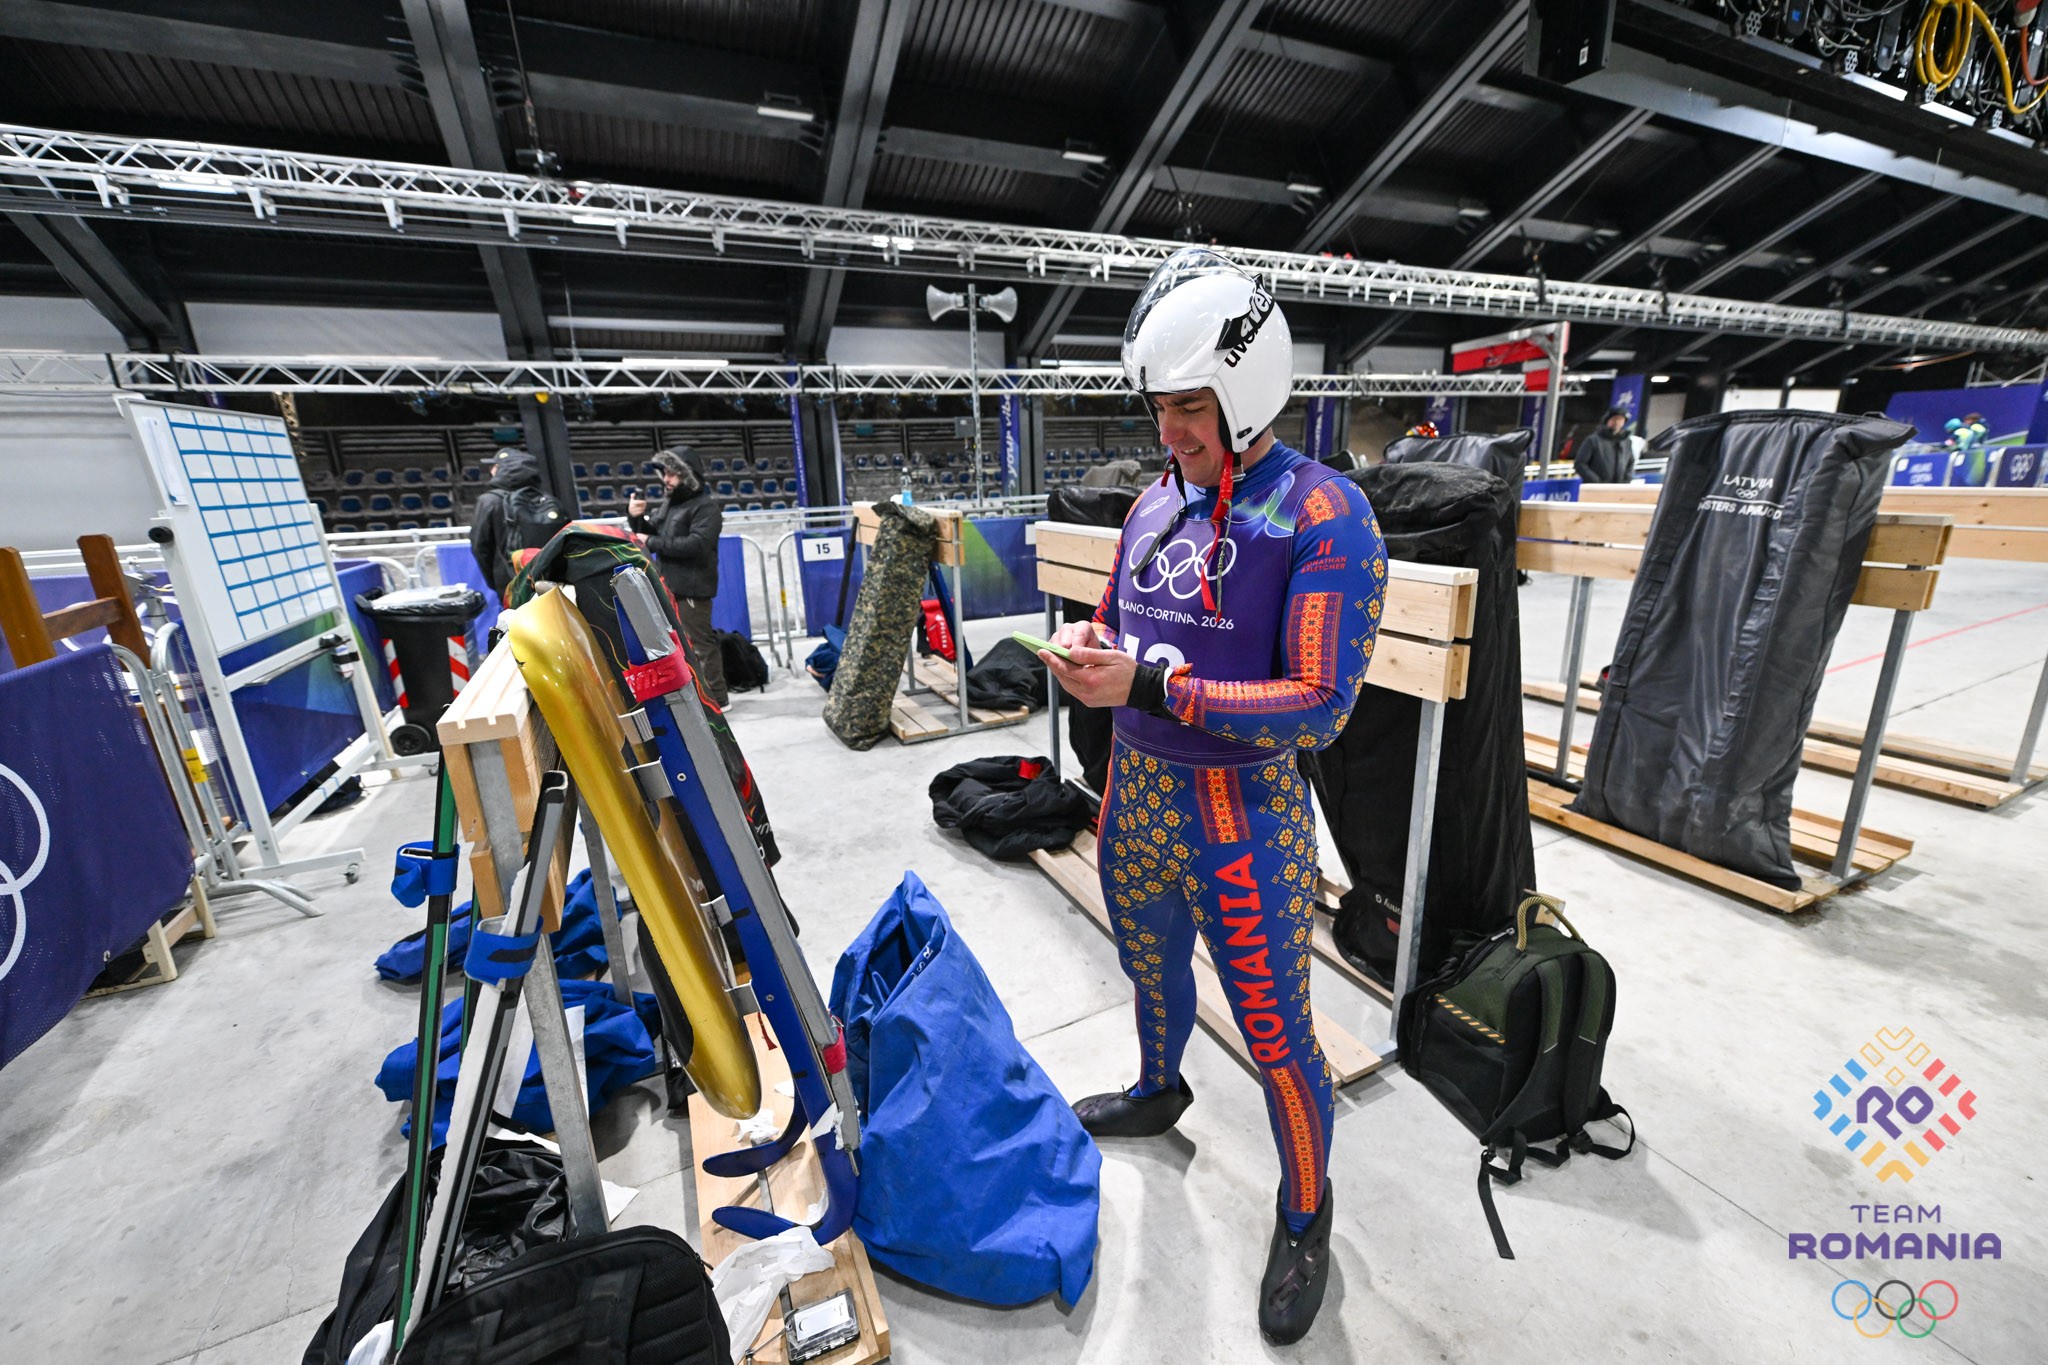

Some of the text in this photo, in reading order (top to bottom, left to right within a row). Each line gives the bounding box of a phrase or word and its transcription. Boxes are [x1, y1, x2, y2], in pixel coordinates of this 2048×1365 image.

[1224, 329, 1259, 368] uve
[816, 543, 831, 555] 15
[1146, 606, 1198, 625] CORTINA
[1201, 615, 1234, 630] 2026
[1214, 852, 1291, 1063] ROMANIA
